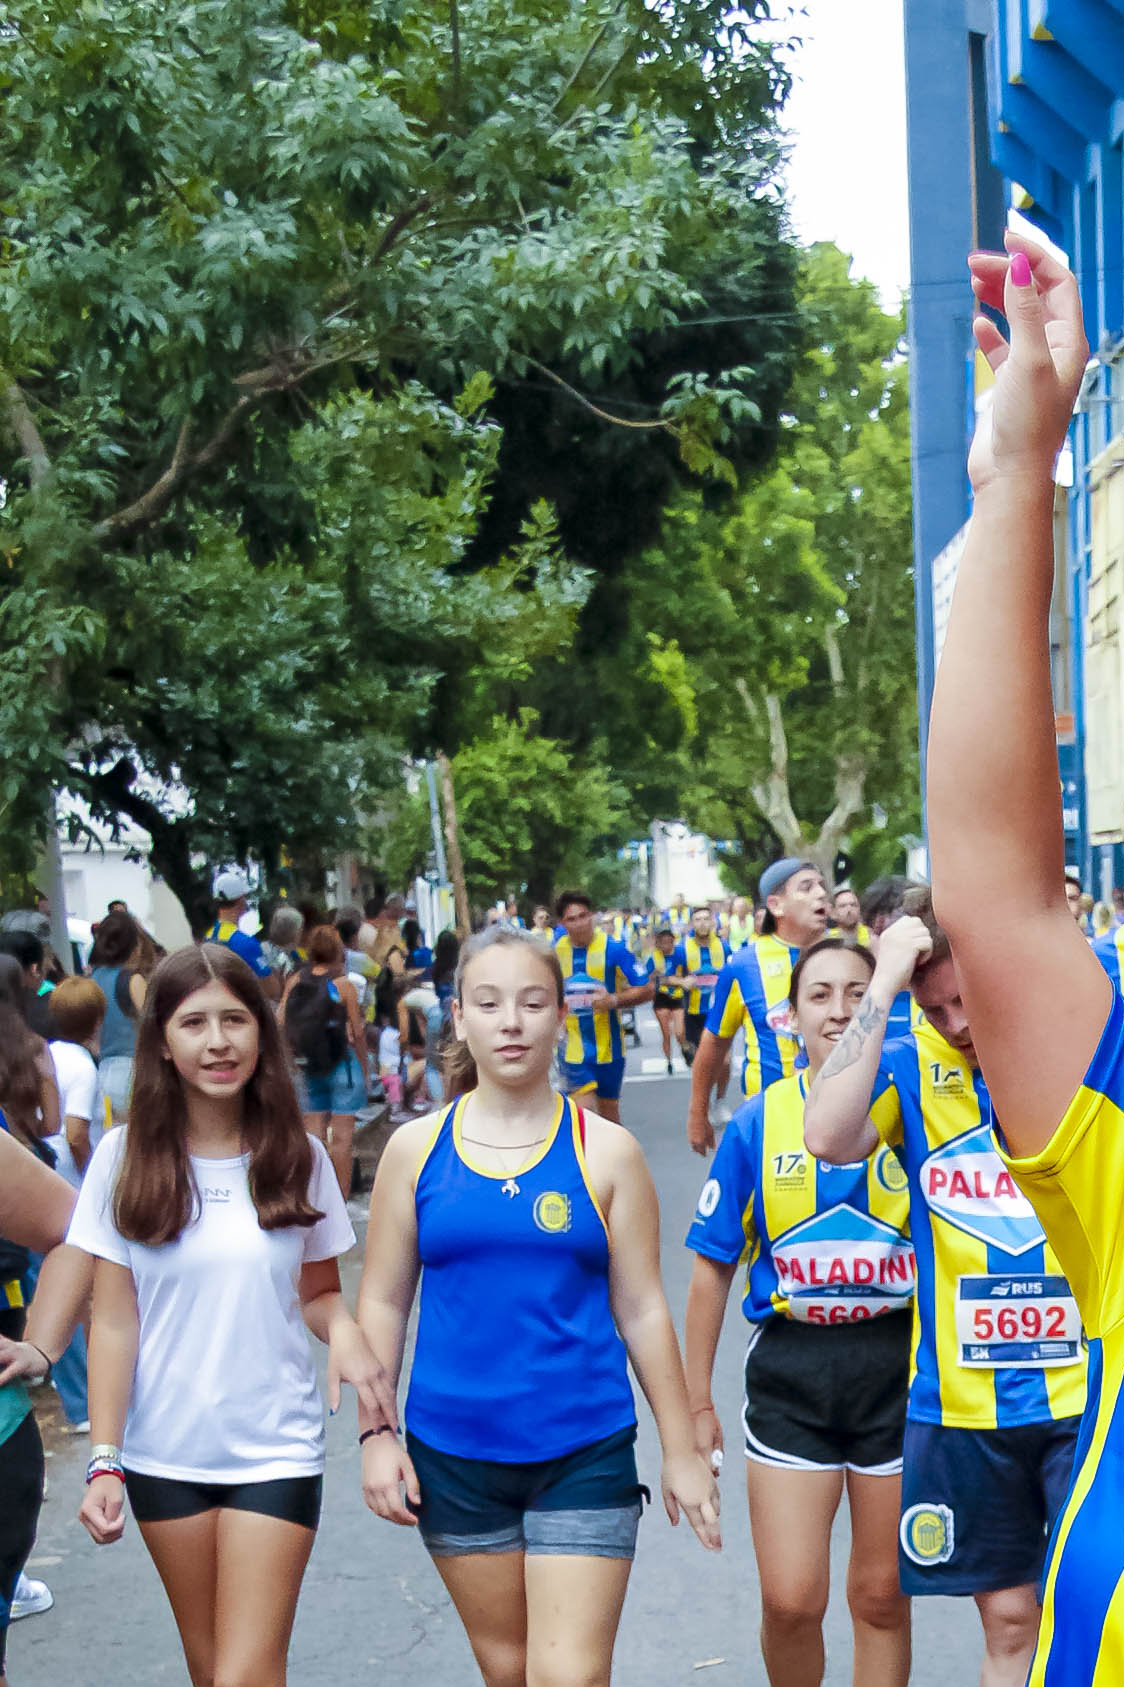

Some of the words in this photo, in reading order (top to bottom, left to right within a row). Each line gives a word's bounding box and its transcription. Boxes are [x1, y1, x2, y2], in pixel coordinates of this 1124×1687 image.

[773, 1154, 803, 1175] 17
[1011, 1281, 1043, 1296] RUS
[973, 1304, 1067, 1341] 5692
